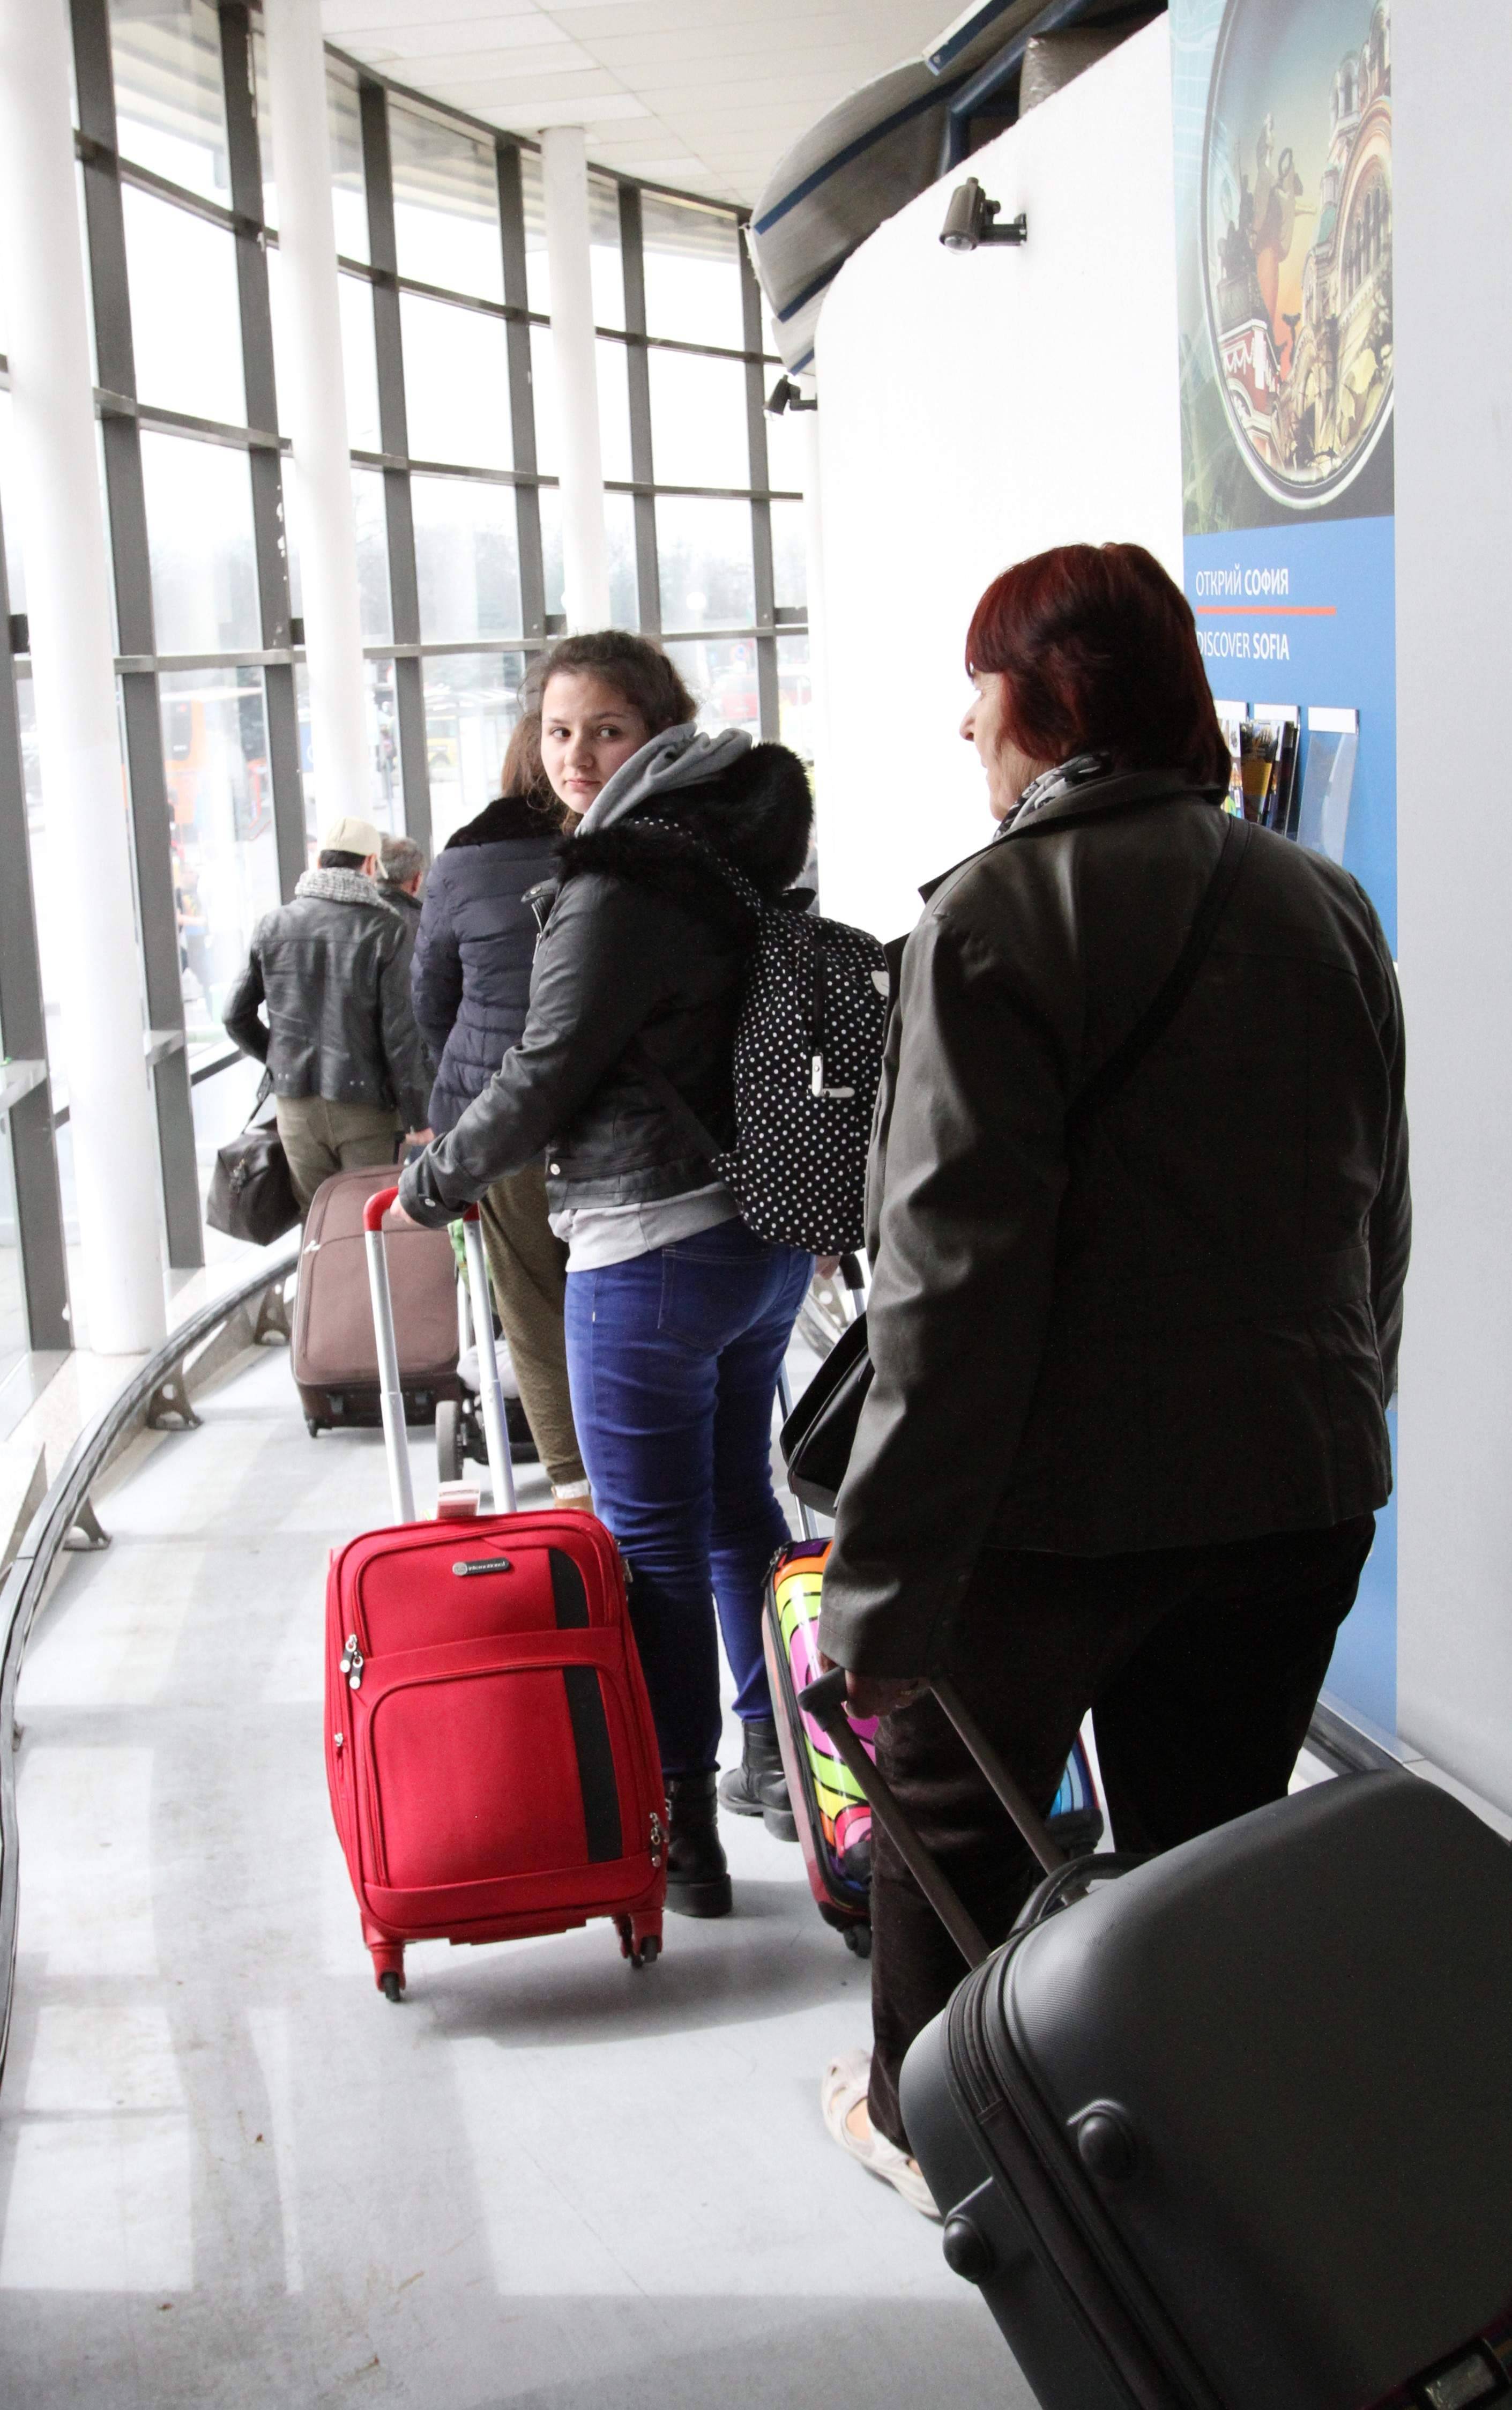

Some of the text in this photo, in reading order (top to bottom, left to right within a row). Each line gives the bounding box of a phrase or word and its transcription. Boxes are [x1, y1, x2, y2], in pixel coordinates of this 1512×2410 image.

[1196, 563, 1289, 596] ОТКРИЙ СОФИЯ
[1253, 632, 1290, 660] SOFIA
